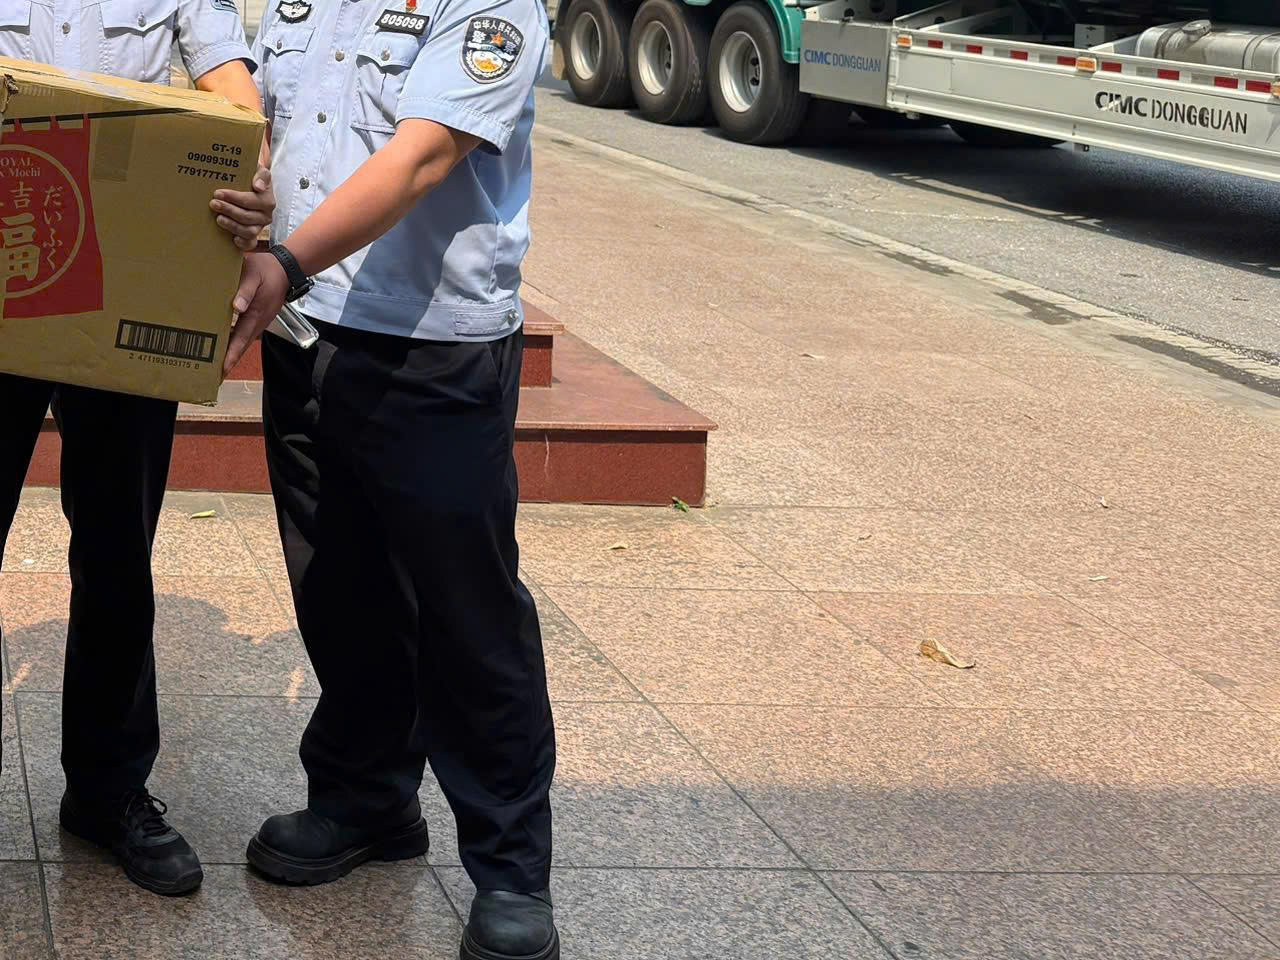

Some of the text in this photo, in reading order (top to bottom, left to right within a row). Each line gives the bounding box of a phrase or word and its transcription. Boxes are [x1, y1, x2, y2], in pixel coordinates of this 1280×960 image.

[380, 13, 425, 30] 805098
[803, 50, 881, 73] CIMC DONGGUAN
[1095, 91, 1248, 135] CIMC DONGGUAN
[212, 143, 242, 156] GT-19
[187, 152, 240, 168] 090993US
[9, 167, 41, 178] Mochi
[177, 165, 236, 182] 779177T&T
